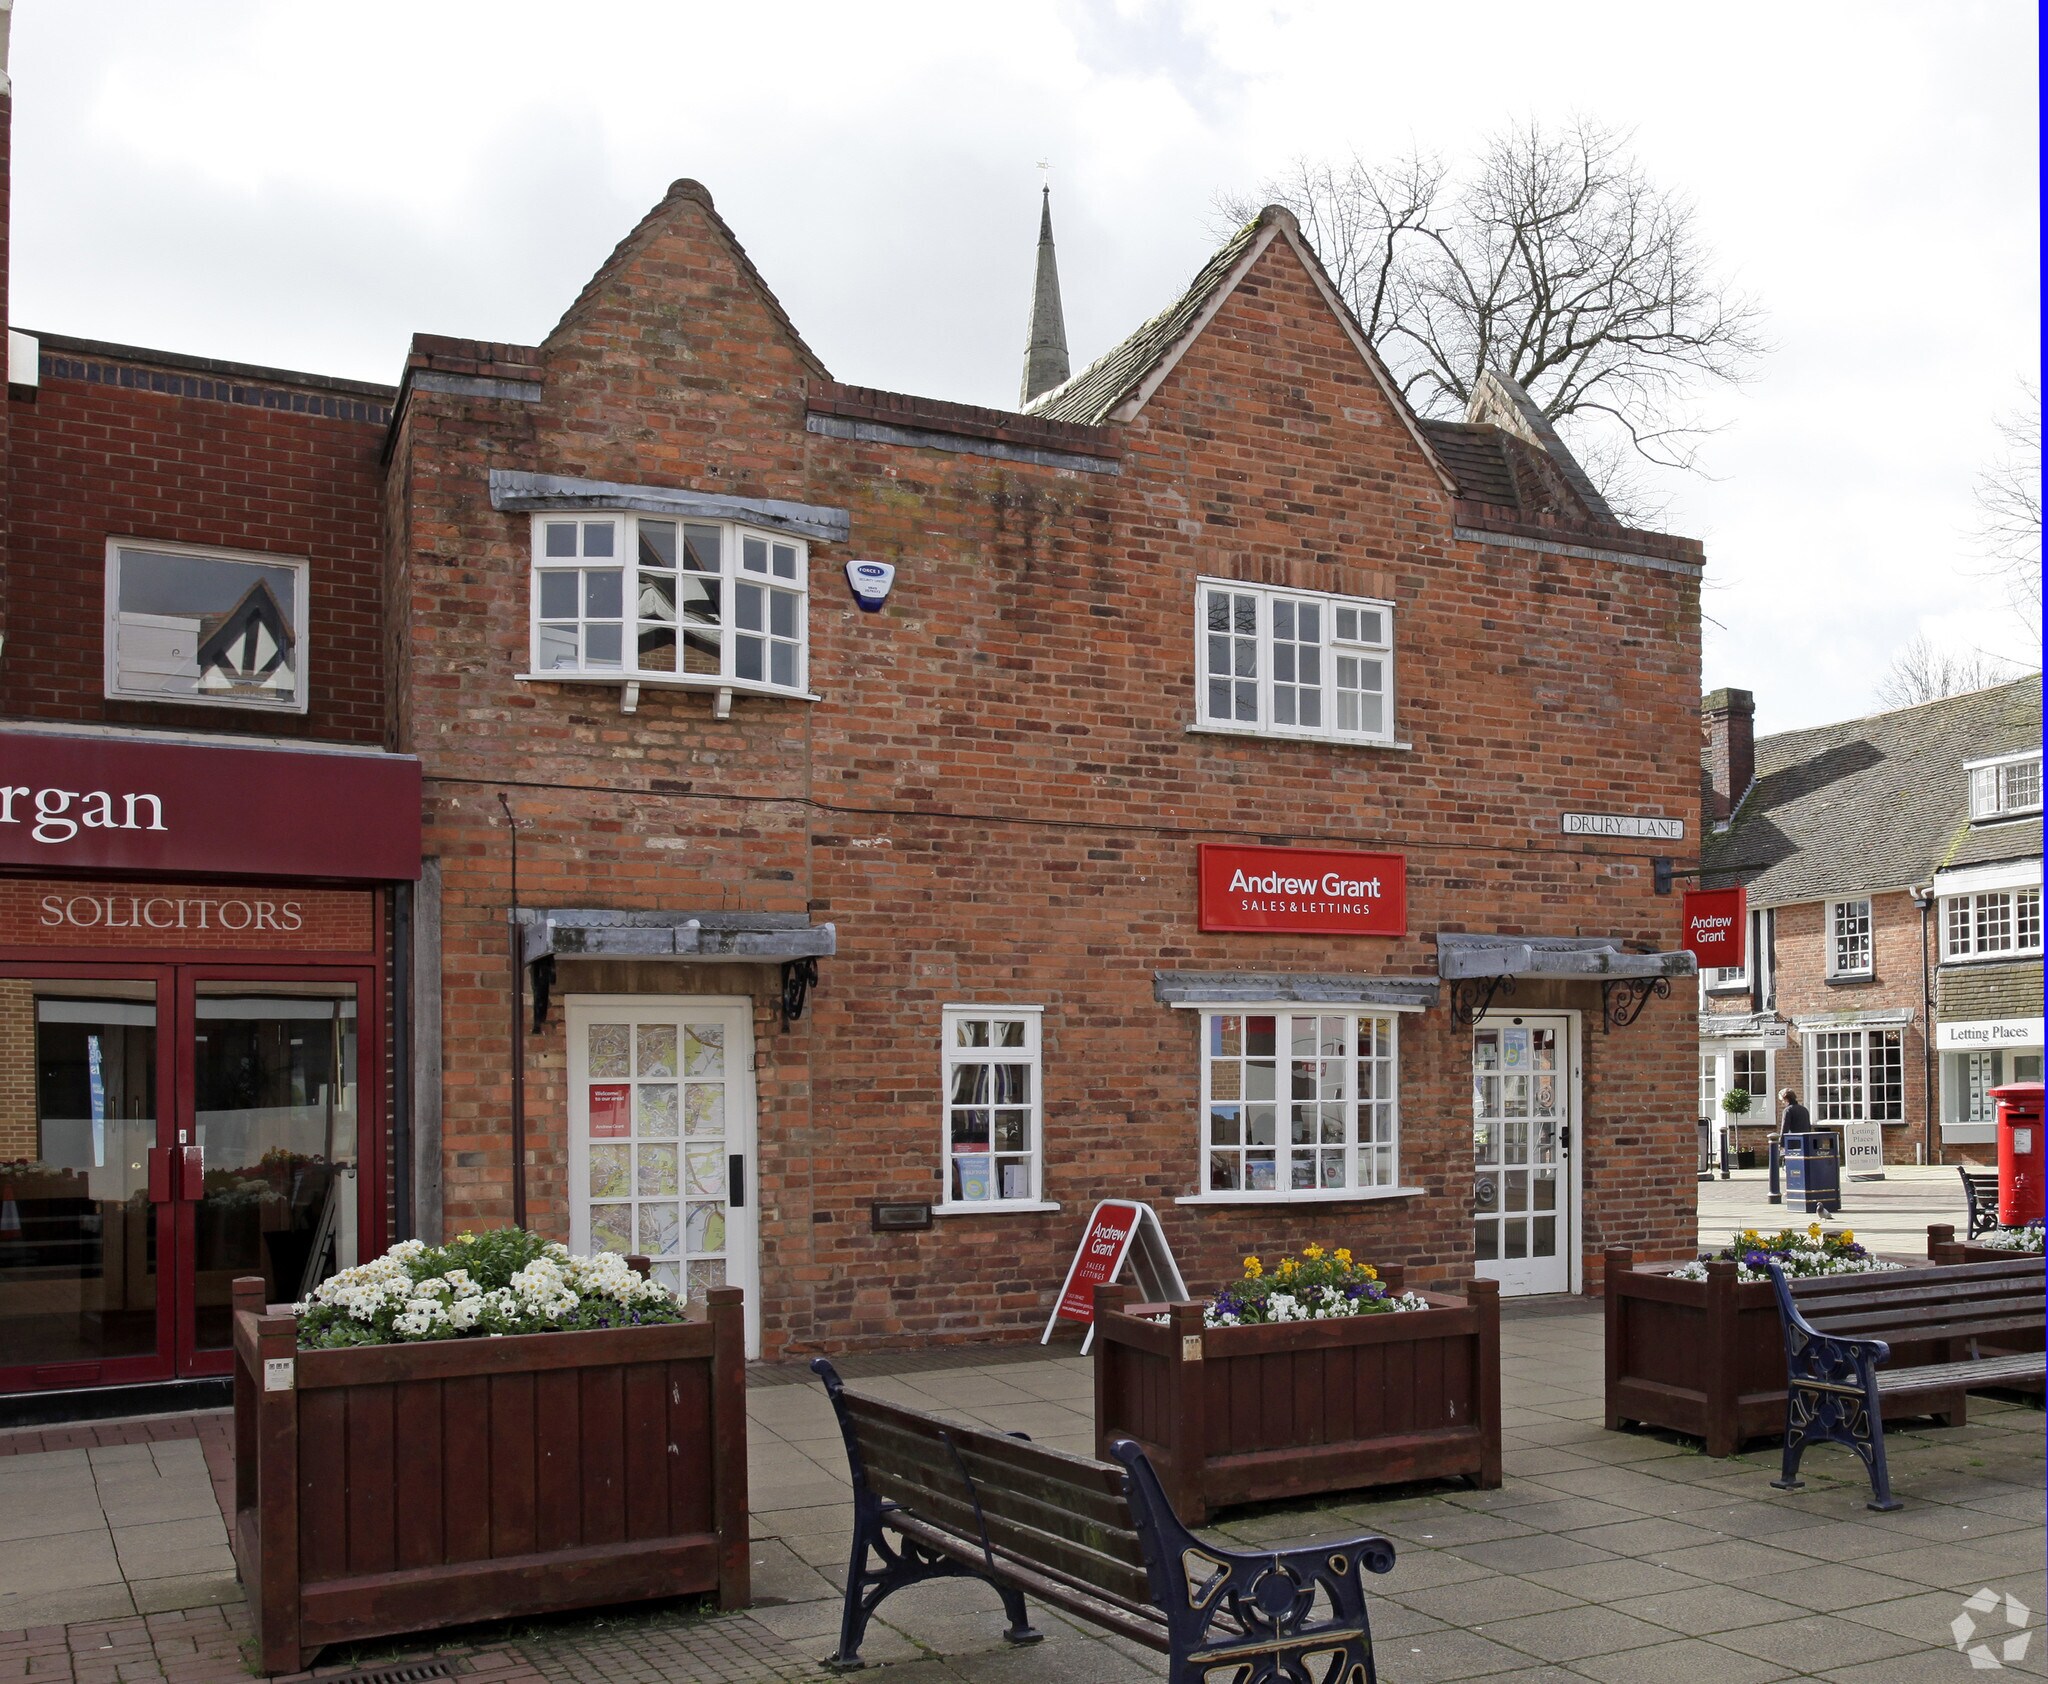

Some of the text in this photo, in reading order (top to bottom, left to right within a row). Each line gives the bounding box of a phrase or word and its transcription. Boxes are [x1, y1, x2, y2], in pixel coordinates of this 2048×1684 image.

[1569, 815, 1679, 837] DRURY LANE
[1228, 868, 1381, 898] Andrew Grant
[40, 895, 303, 931] SOLICITORS
[1690, 915, 1732, 929] Andrew
[1696, 929, 1726, 943] Grant
[1950, 1025, 2029, 1042] Letting Places
[1851, 1128, 1875, 1136] Letting
[1850, 1145, 1878, 1156] OPEN
[1091, 1222, 1126, 1241] Andrew
[1091, 1238, 1115, 1256] Grant
[1079, 1270, 1105, 1281] LETTINGS
